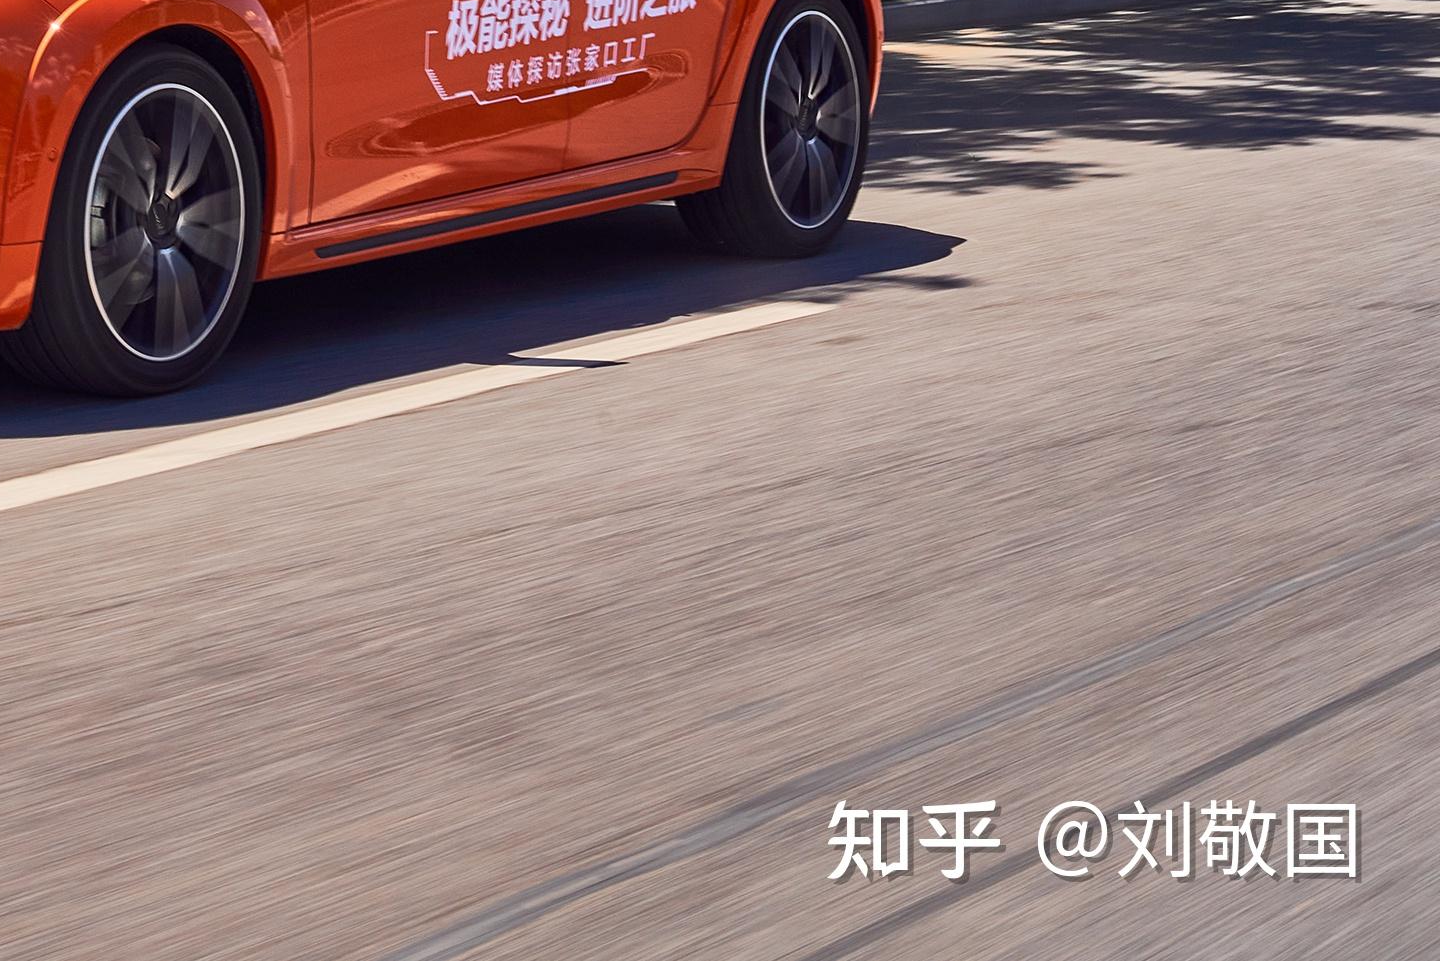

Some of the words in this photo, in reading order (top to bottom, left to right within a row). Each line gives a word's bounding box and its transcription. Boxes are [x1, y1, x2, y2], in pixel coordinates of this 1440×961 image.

[486, 32, 655, 92] 媒体探访张家口工厂
